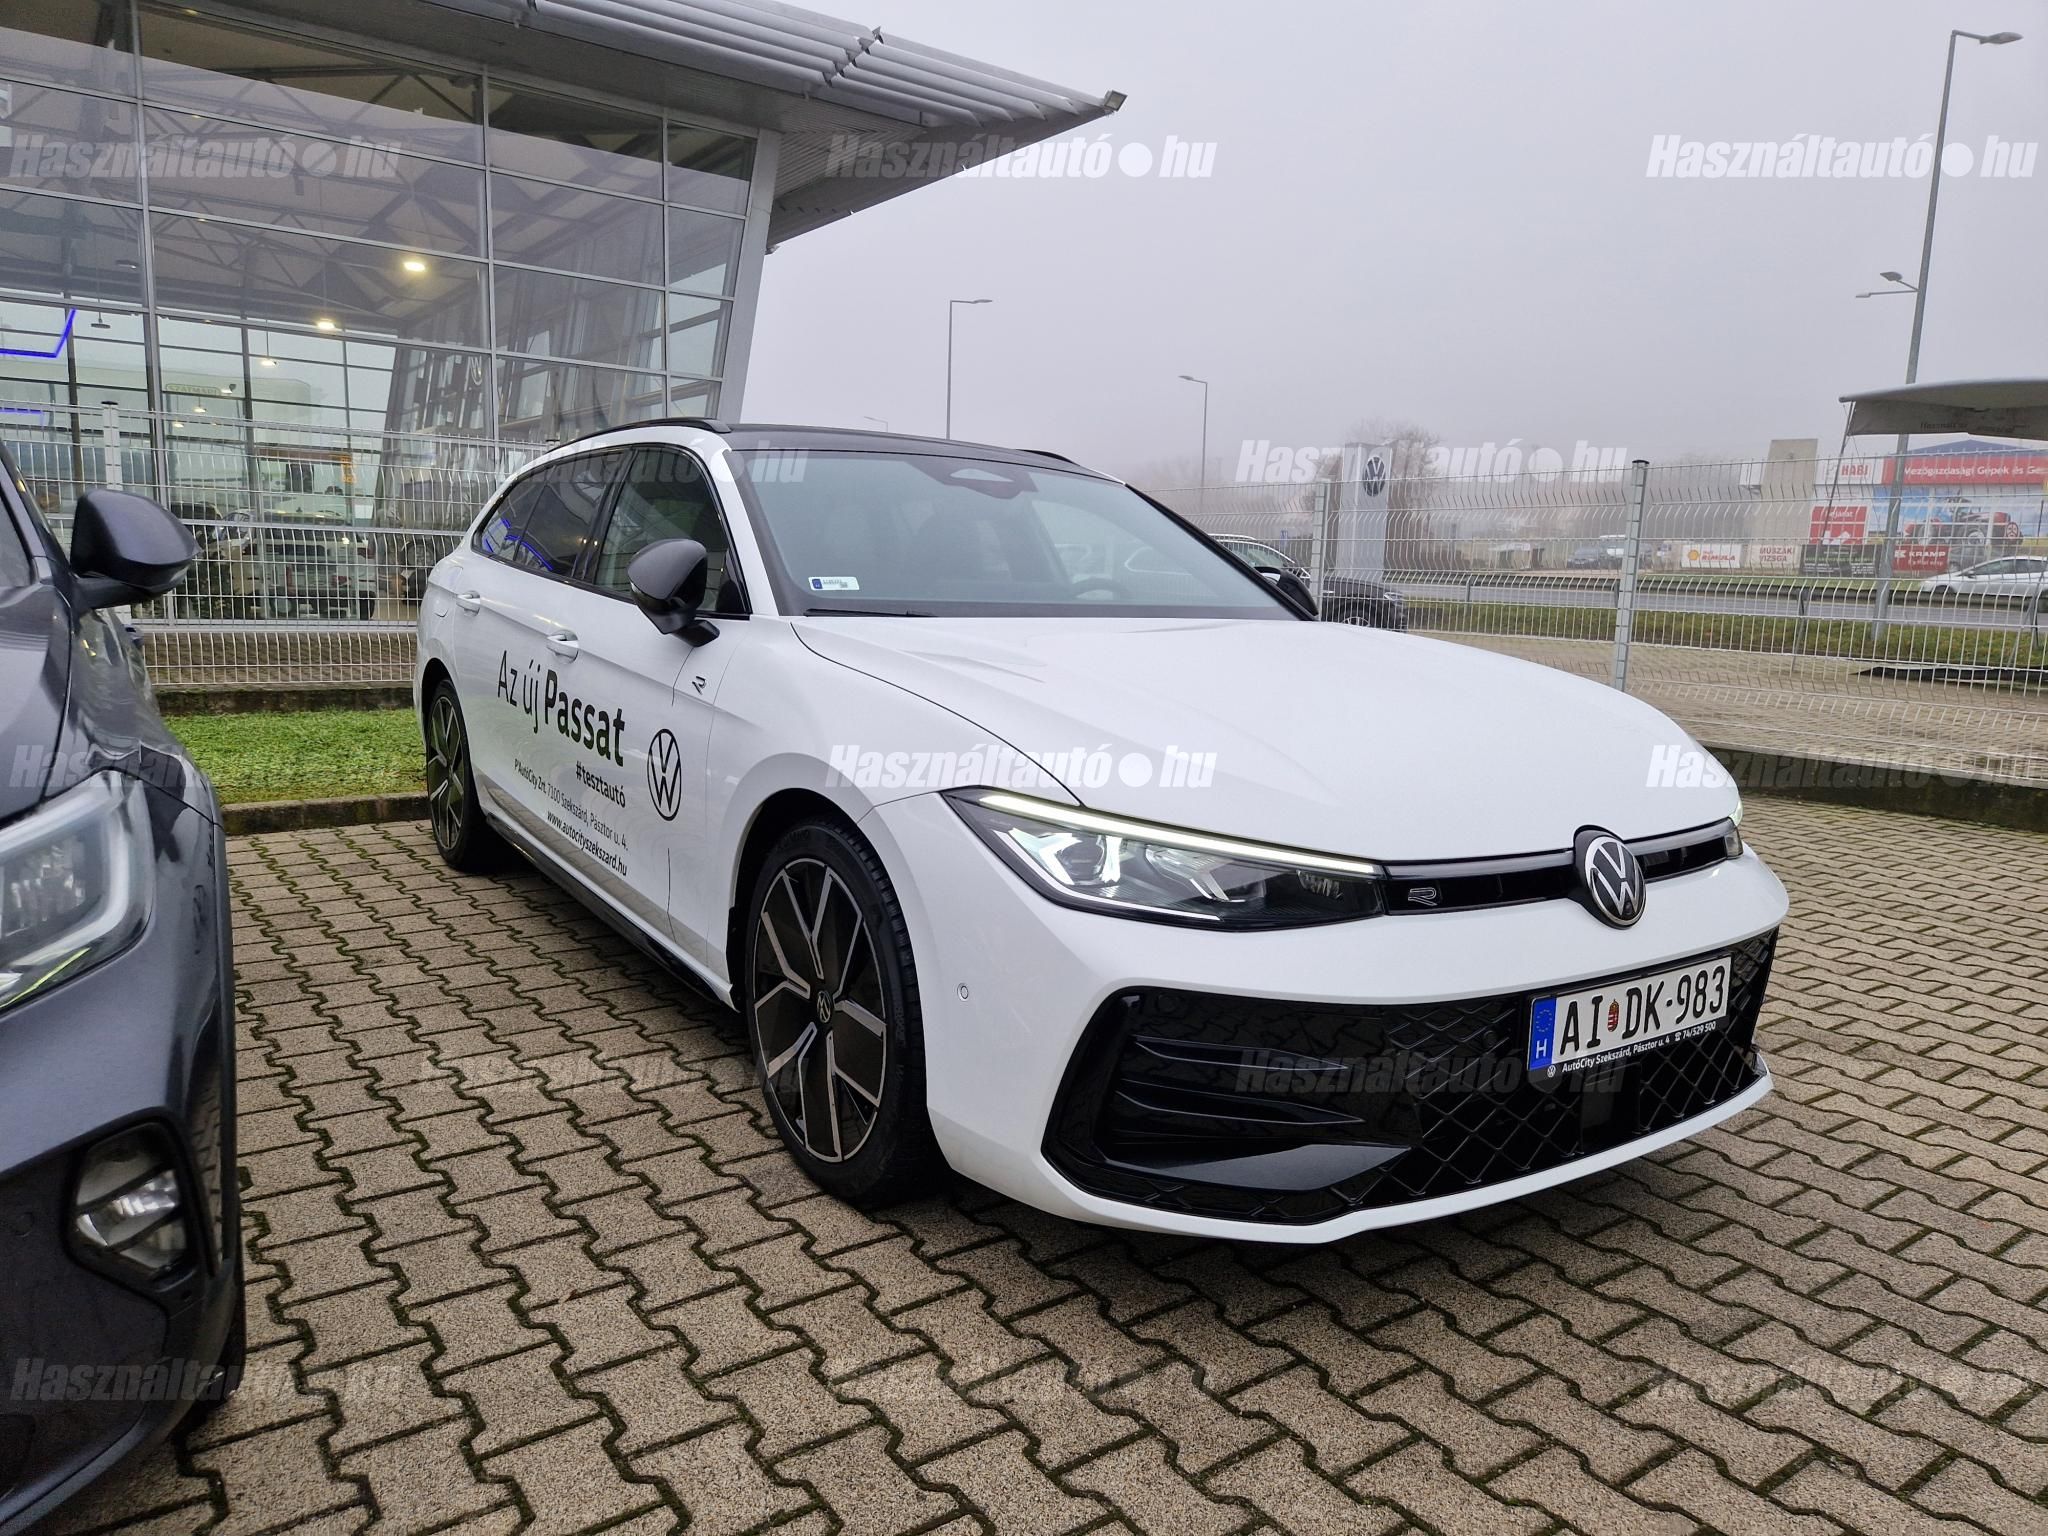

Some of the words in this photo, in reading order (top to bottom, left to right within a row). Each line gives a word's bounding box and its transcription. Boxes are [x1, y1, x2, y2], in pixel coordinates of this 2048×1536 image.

[498, 650, 518, 707] Az
[523, 659, 539, 734] új
[545, 669, 625, 767] Passat
[576, 760, 626, 808] #tesztautó
[547, 811, 627, 876] www.autocityszekszard.hu
[1561, 1056, 1596, 1073] AutóCity
[1595, 1045, 1632, 1066] Szekszárd,
[1633, 1040, 1658, 1055] Pásztor
[1682, 1024, 1704, 1040] 74/529
[1704, 1020, 1717, 1033] 500
